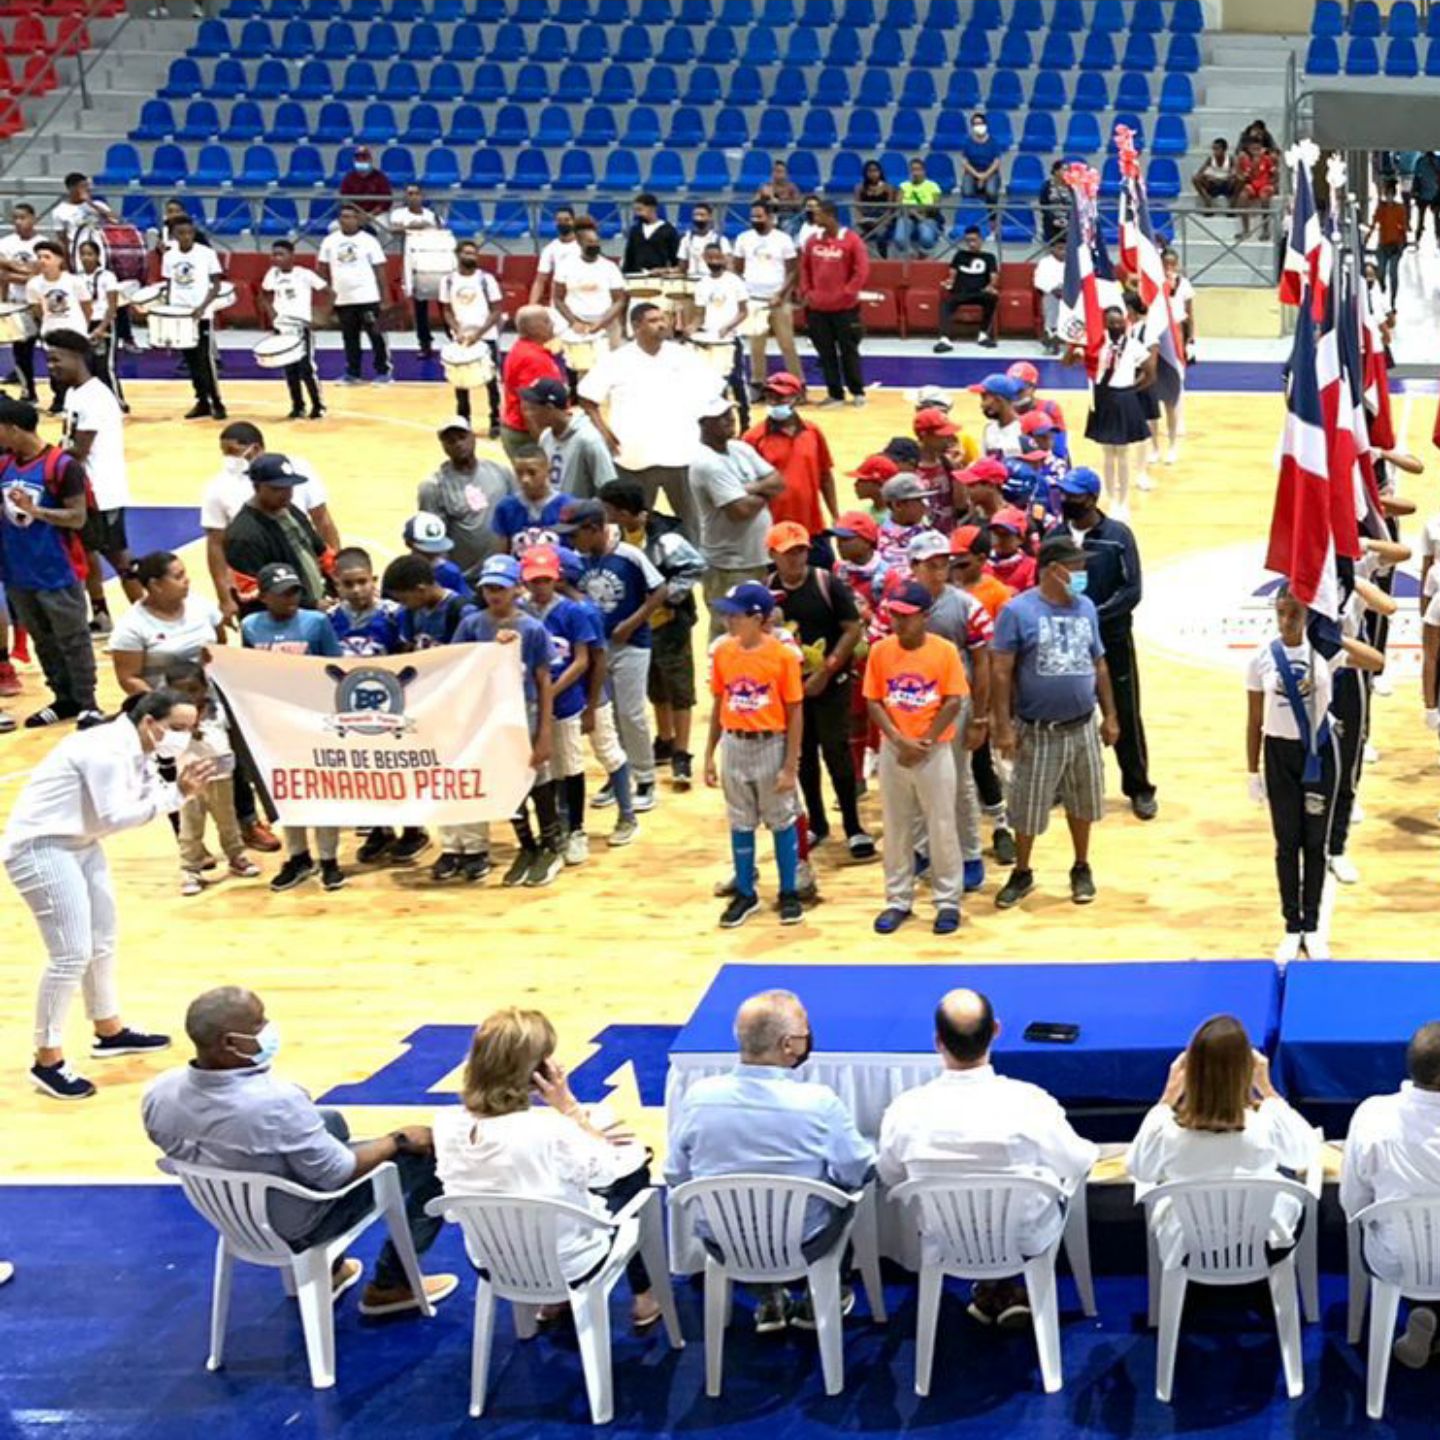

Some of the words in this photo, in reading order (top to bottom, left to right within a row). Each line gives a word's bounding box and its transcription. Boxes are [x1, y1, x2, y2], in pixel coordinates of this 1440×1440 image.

[355, 688, 389, 711] BP
[313, 748, 346, 768] LIGA
[350, 749, 370, 769] DE
[373, 748, 441, 769] BEISBOL
[272, 768, 407, 801] BERNARDO
[414, 768, 486, 801] PEREZ
